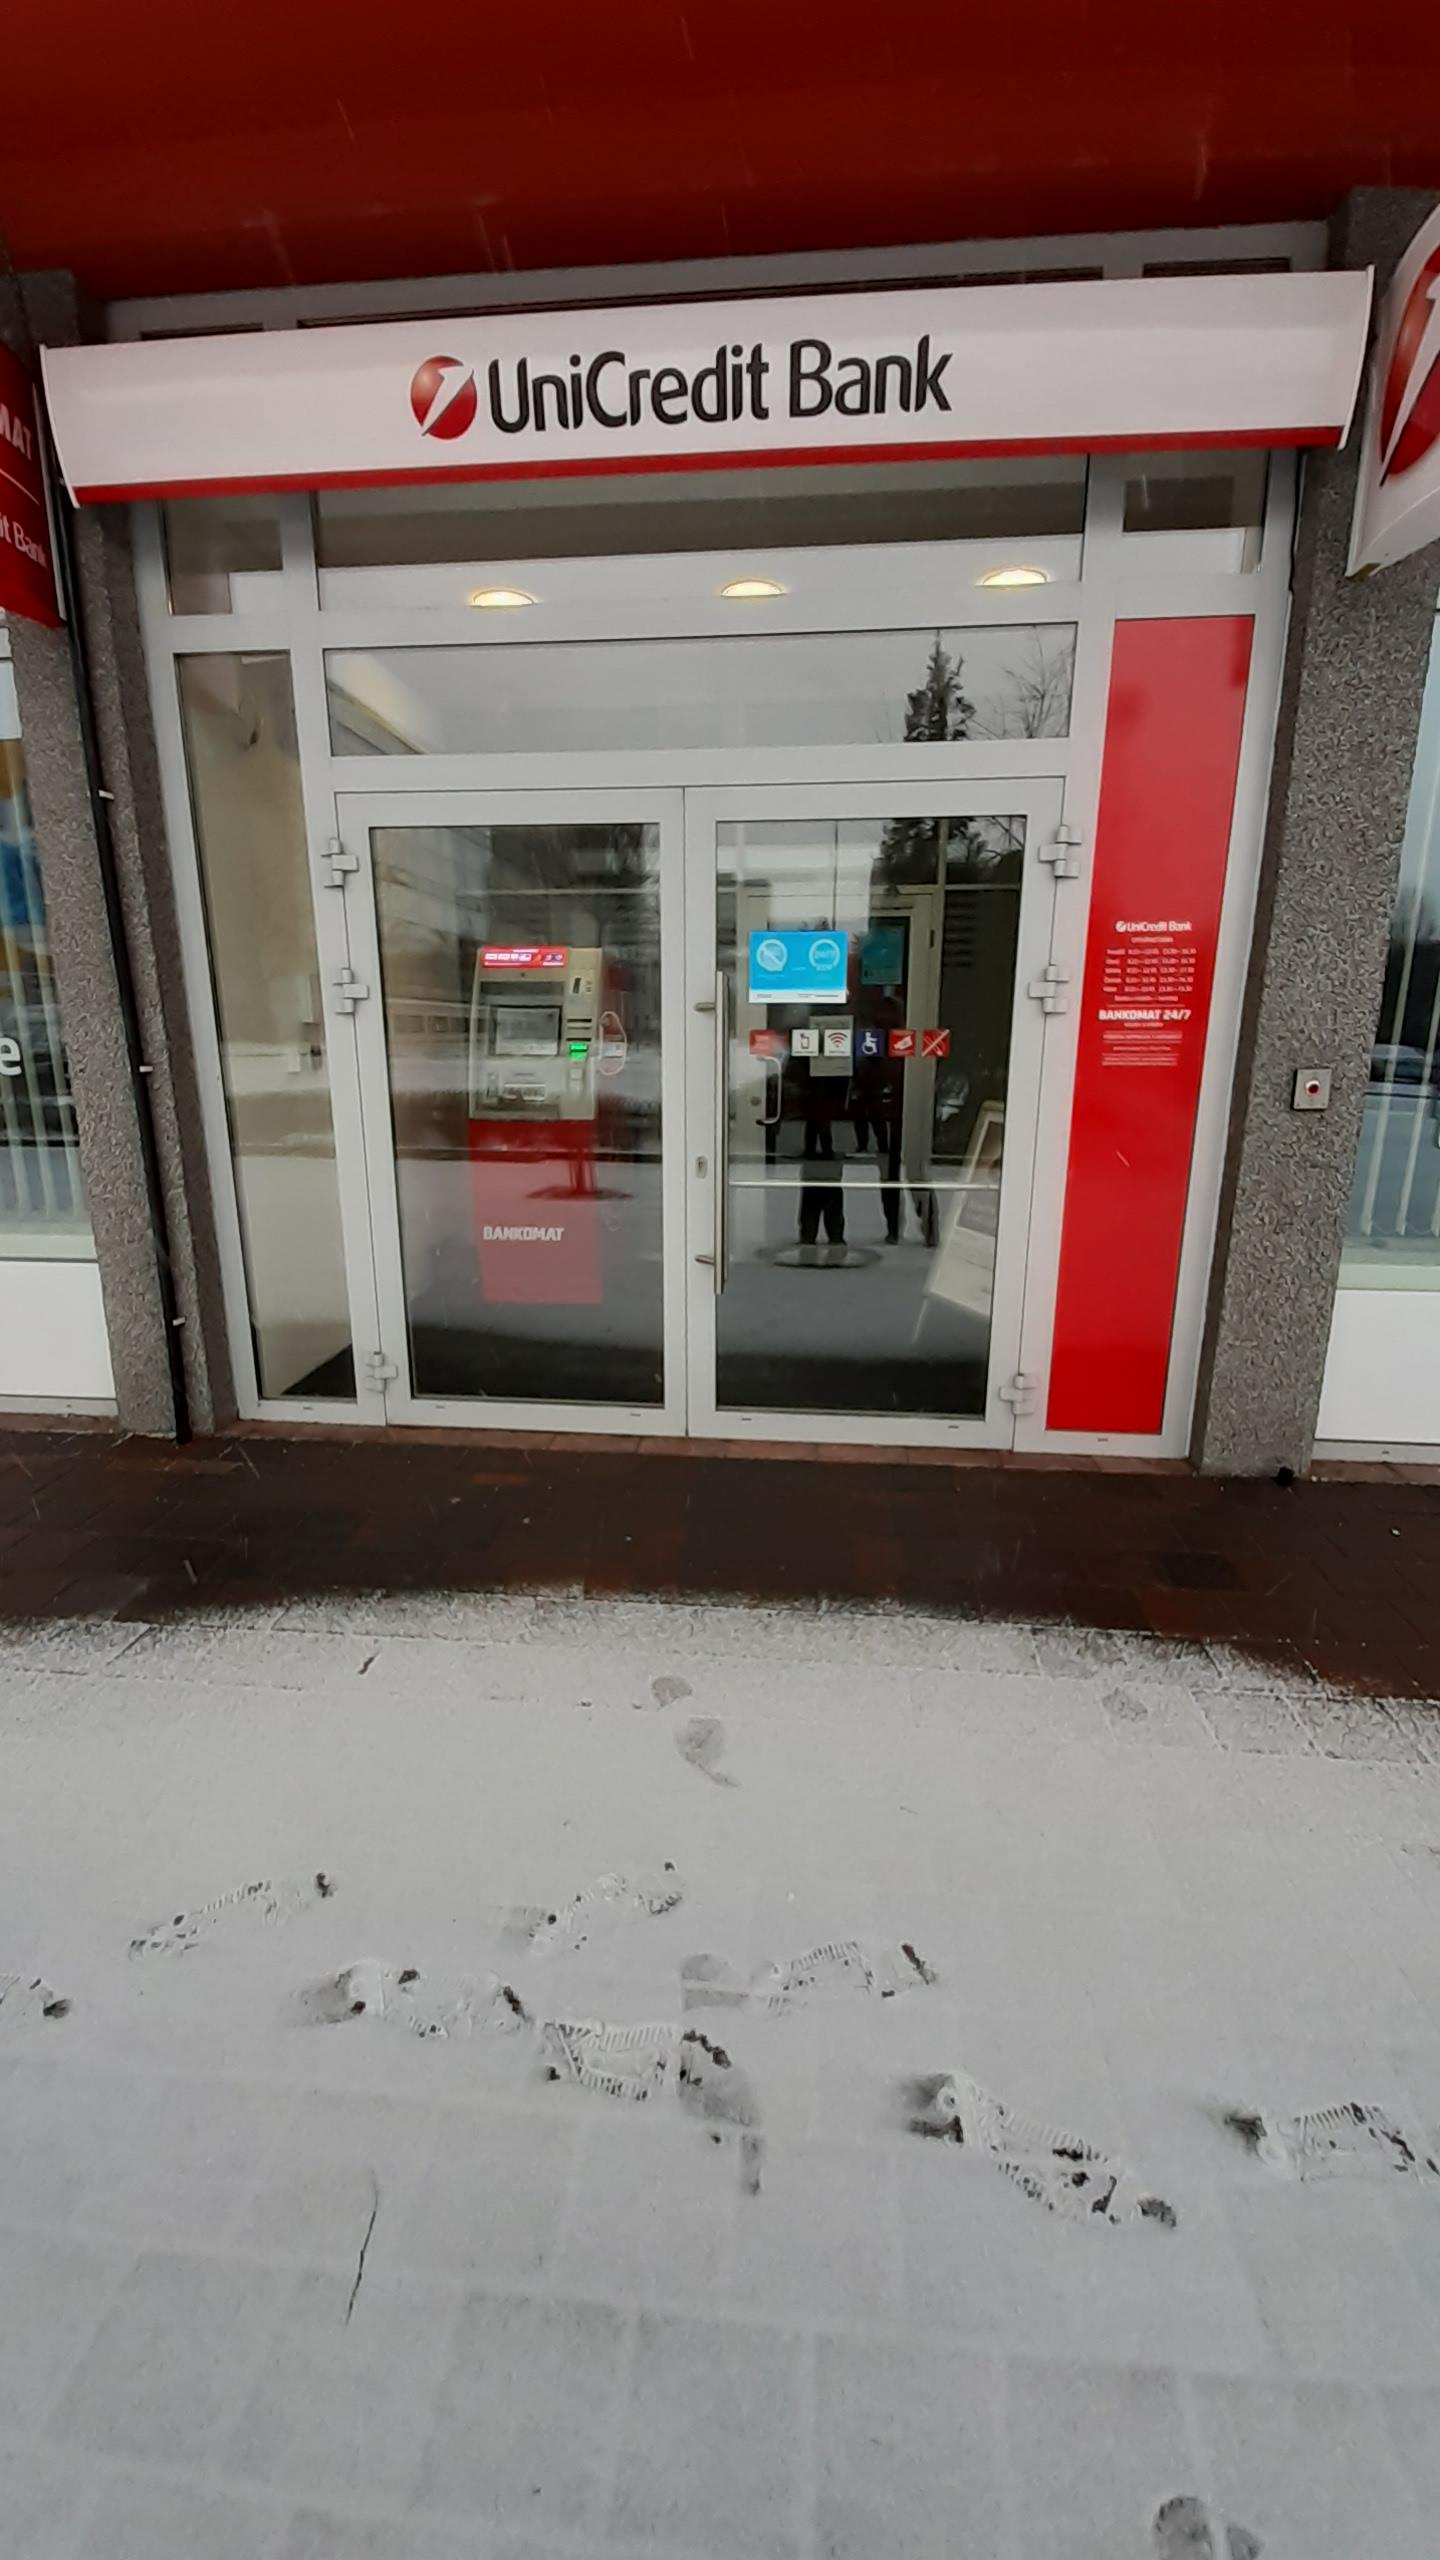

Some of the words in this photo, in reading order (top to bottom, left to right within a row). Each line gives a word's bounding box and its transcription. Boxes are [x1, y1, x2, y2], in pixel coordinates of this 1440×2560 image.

[487, 343, 769, 433] UniCredit
[789, 334, 953, 418] Bank
[12, 521, 48, 571] Bank
[1127, 920, 1167, 932] UniCredit
[1168, 920, 1193, 932] Bank
[1098, 1009, 1161, 1021] BANKOMAT
[1163, 1009, 1192, 1021] 24/7
[483, 1225, 565, 1242] BANKOMAT
